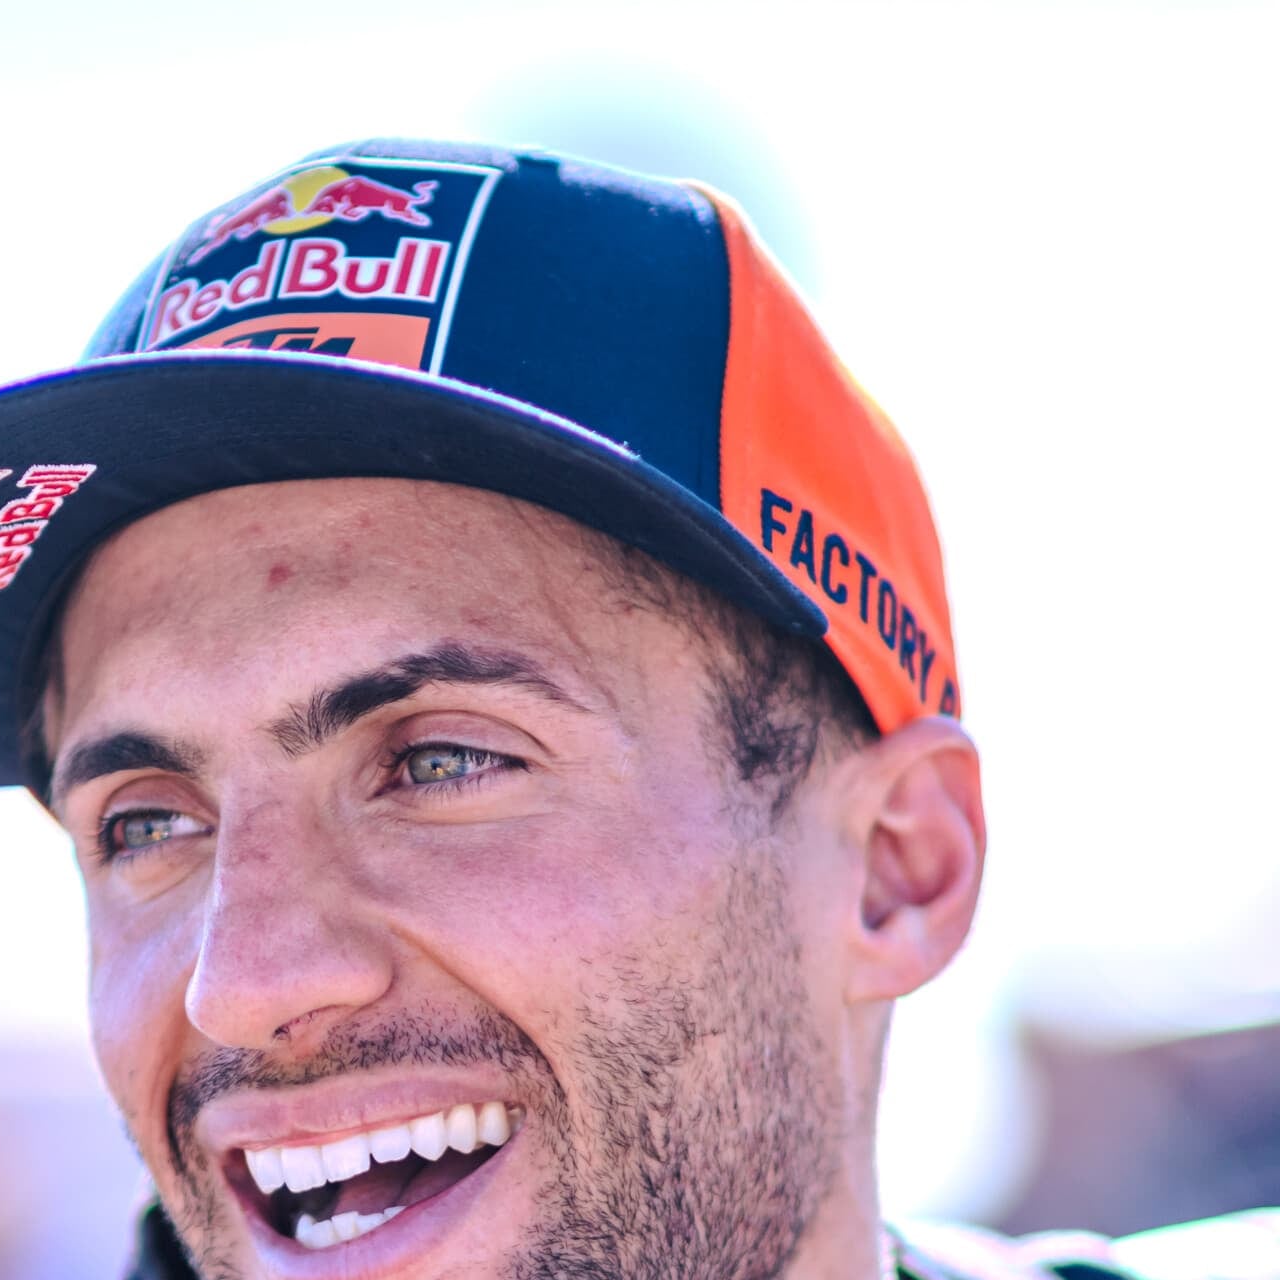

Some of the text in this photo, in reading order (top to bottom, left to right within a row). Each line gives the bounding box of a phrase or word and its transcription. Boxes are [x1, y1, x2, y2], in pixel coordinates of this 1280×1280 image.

[148, 237, 451, 346] Red Bull
[760, 488, 936, 704] FACTORY
